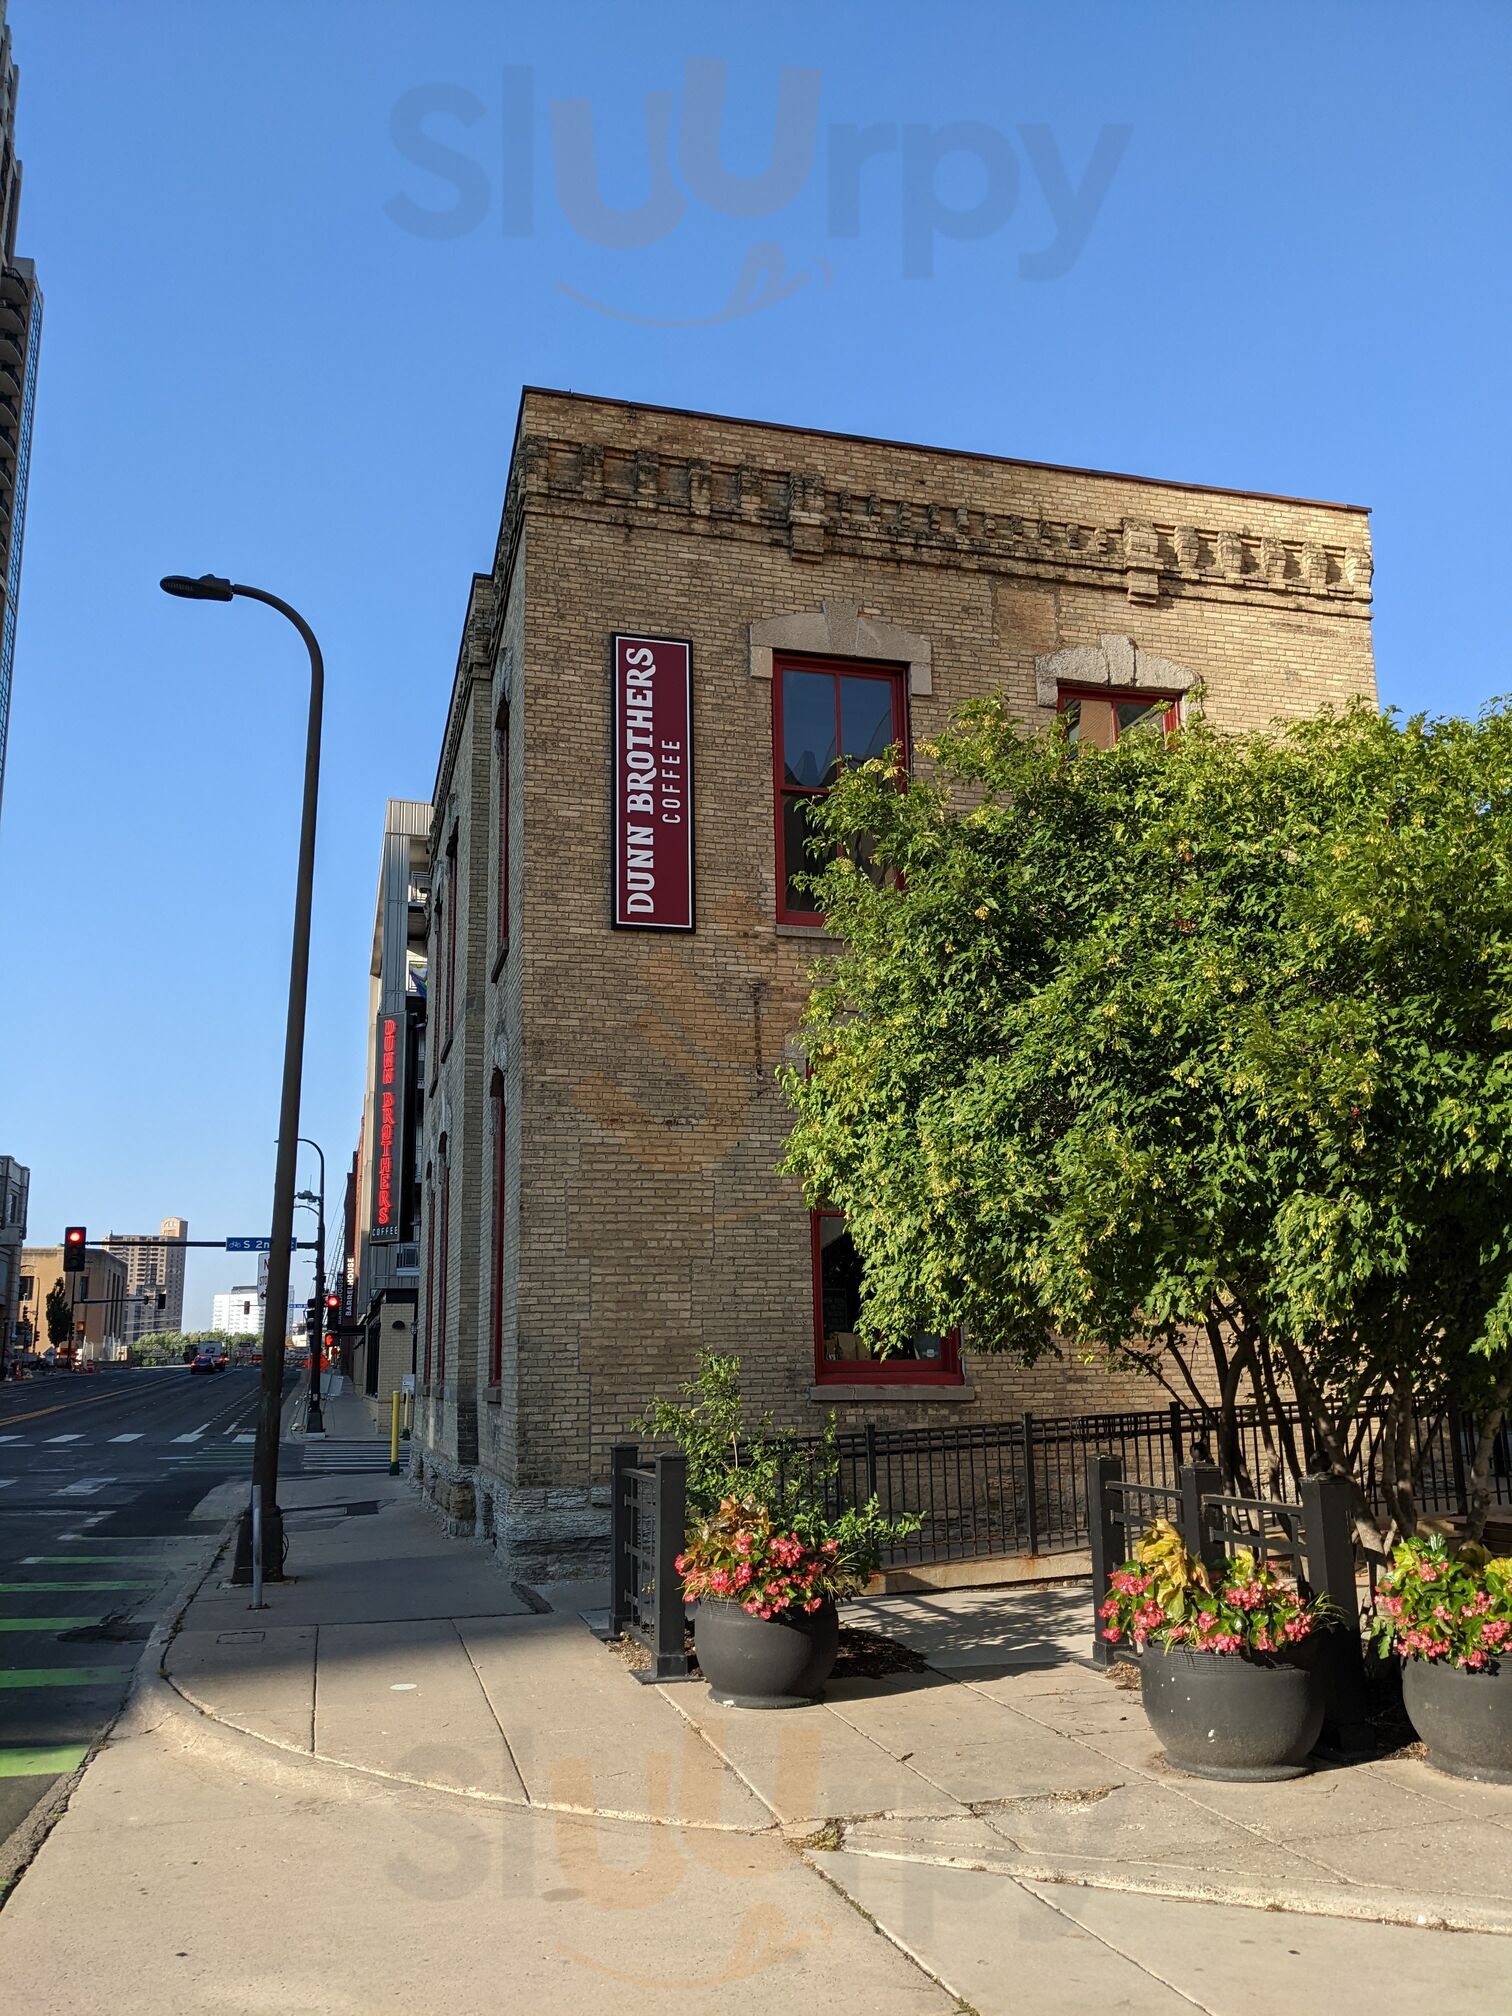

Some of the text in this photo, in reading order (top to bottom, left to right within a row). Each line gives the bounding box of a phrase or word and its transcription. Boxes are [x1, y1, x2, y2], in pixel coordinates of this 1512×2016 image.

[626, 647, 657, 915] DUNN BROTHERS
[661, 739, 681, 824] COFFEE
[378, 1019, 396, 1225] DUNN BROTHERS
[243, 1240, 270, 1249] S 2n
[372, 1225, 398, 1237] COFFEE
[345, 1257, 355, 1316] BARRELHOUSE
